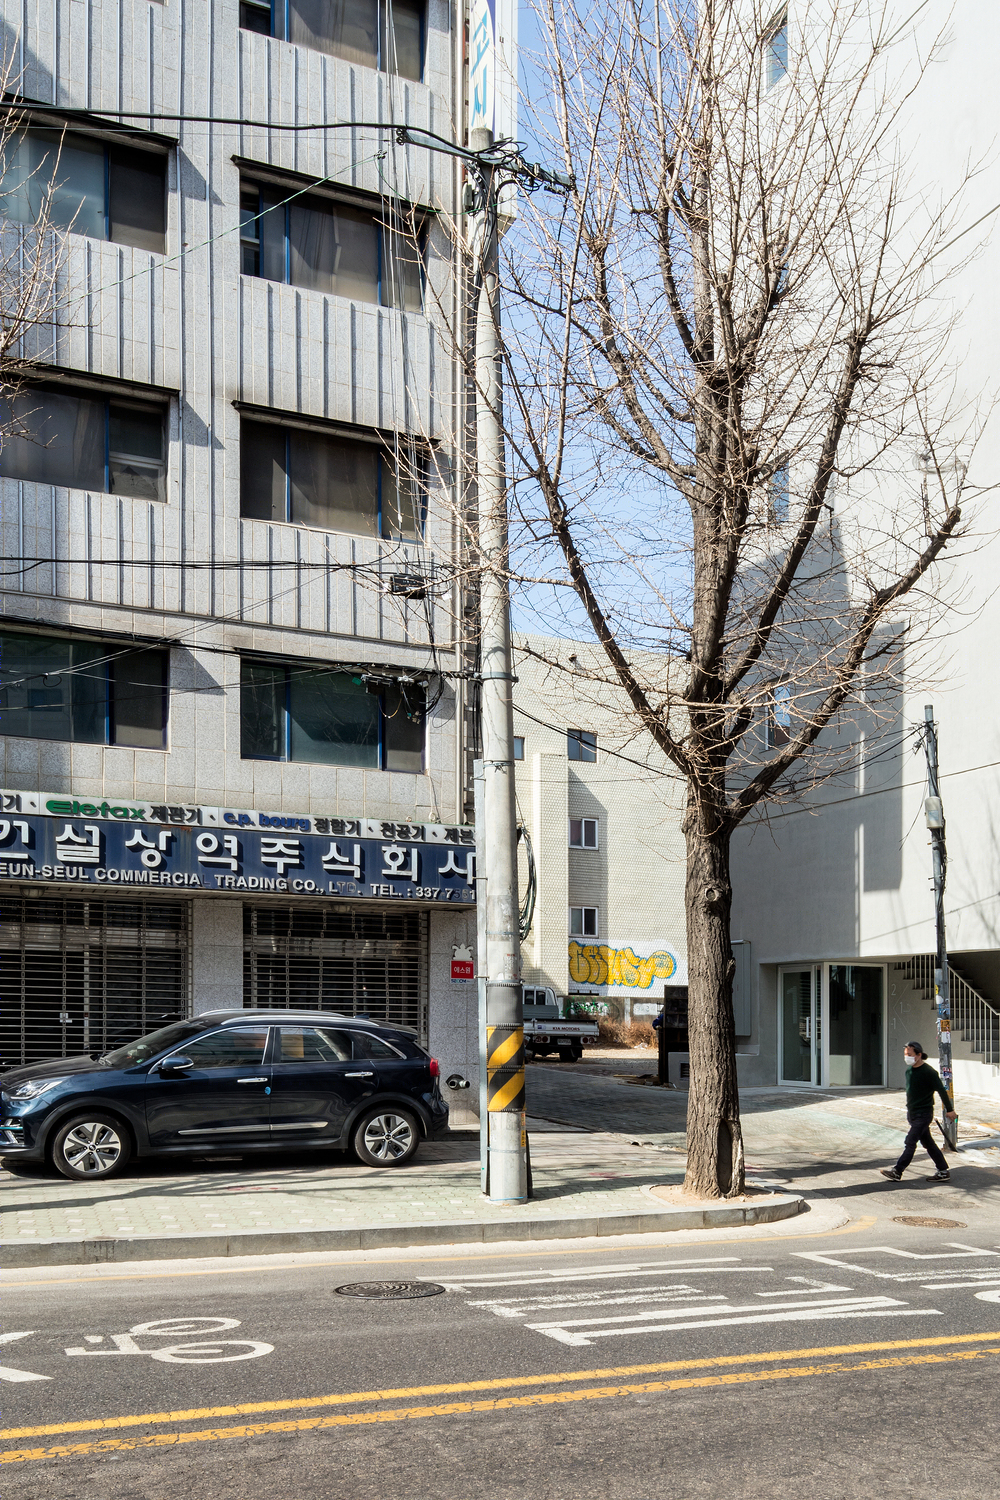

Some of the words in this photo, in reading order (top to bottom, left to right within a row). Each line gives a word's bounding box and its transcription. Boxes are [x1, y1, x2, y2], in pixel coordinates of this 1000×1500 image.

[470, 10, 490, 128] 고시
[46, 799, 146, 819] Elefax
[150, 805, 203, 825] 제판기
[223, 812, 254, 826] c.p.
[259, 813, 311, 831] bourg
[313, 817, 361, 836] 정합기
[380, 822, 426, 841] 천공기
[215, 874, 288, 890] TRADING
[370, 883, 402, 896] TEL.
[453, 966, 471, 974] 에스원
